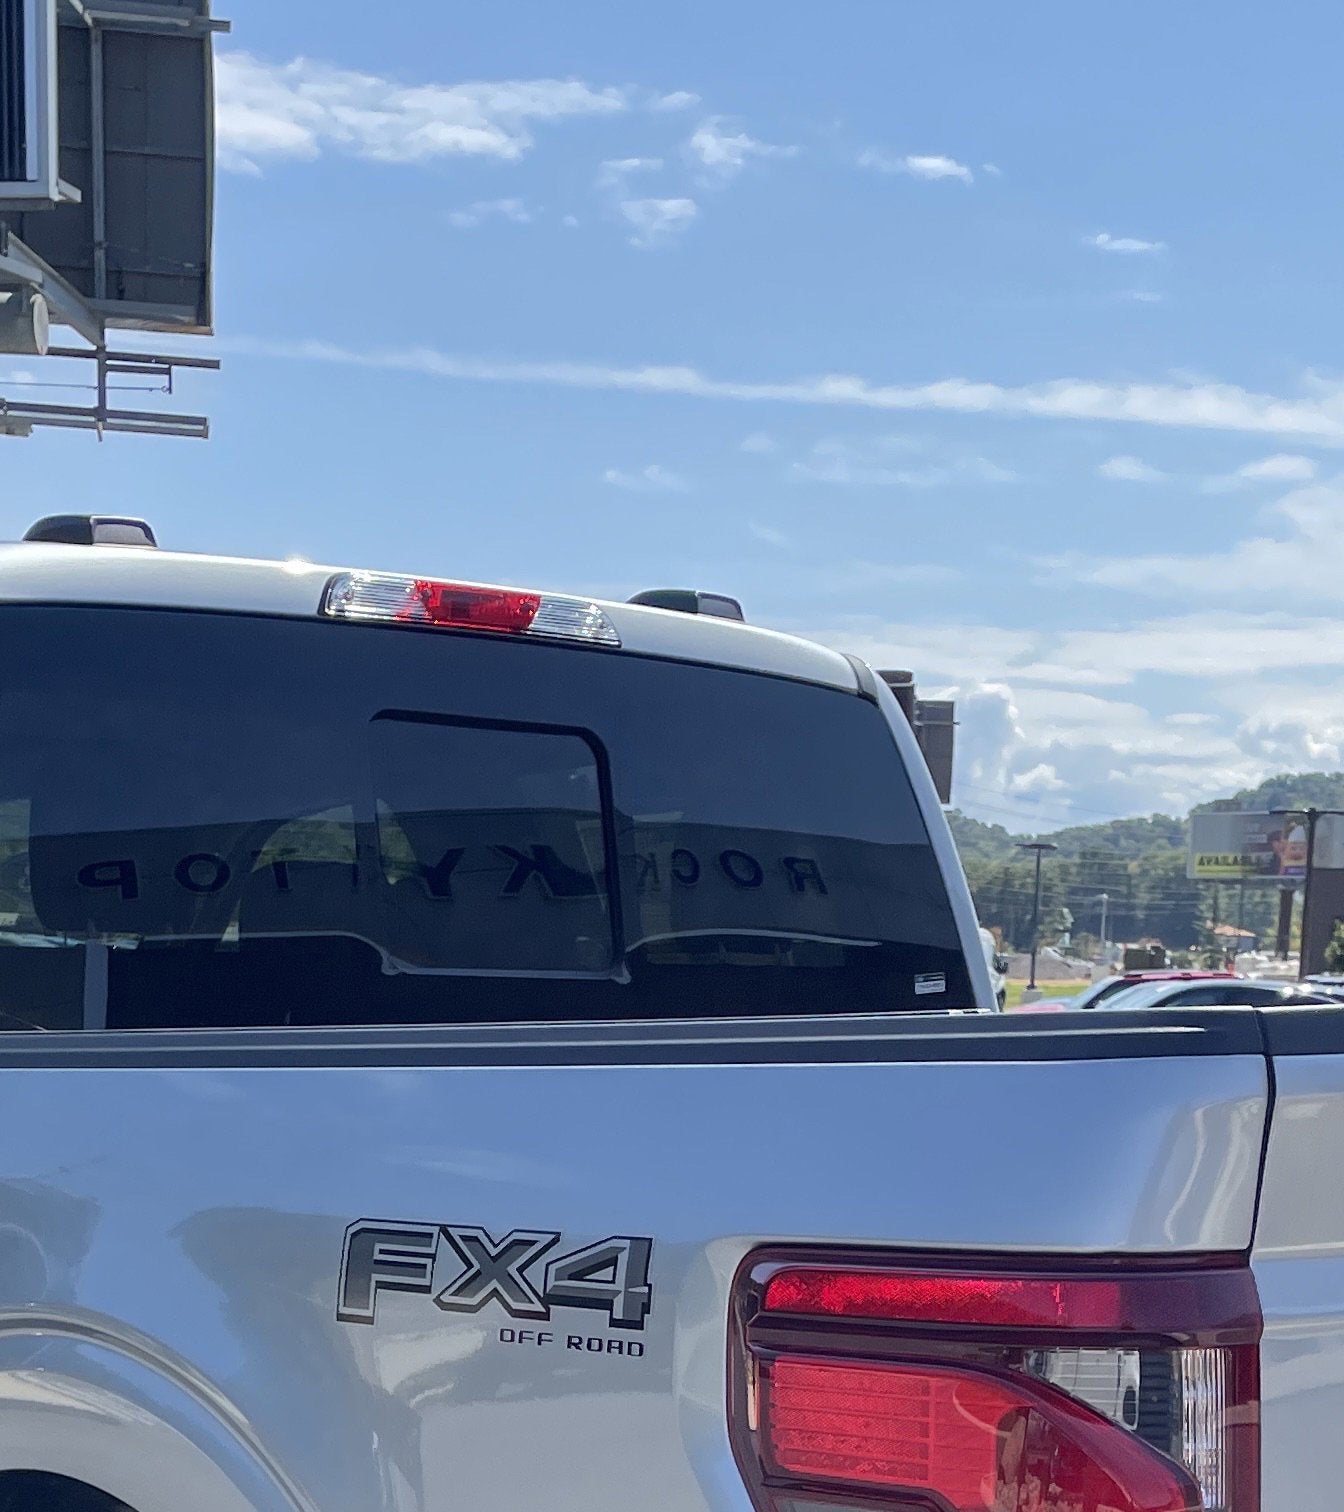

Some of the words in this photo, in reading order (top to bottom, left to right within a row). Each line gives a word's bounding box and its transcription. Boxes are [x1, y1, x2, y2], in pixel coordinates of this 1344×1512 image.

[336, 1217, 654, 1331] FX4
[499, 1328, 553, 1346] OFF
[566, 1335, 644, 1357] ROAD
